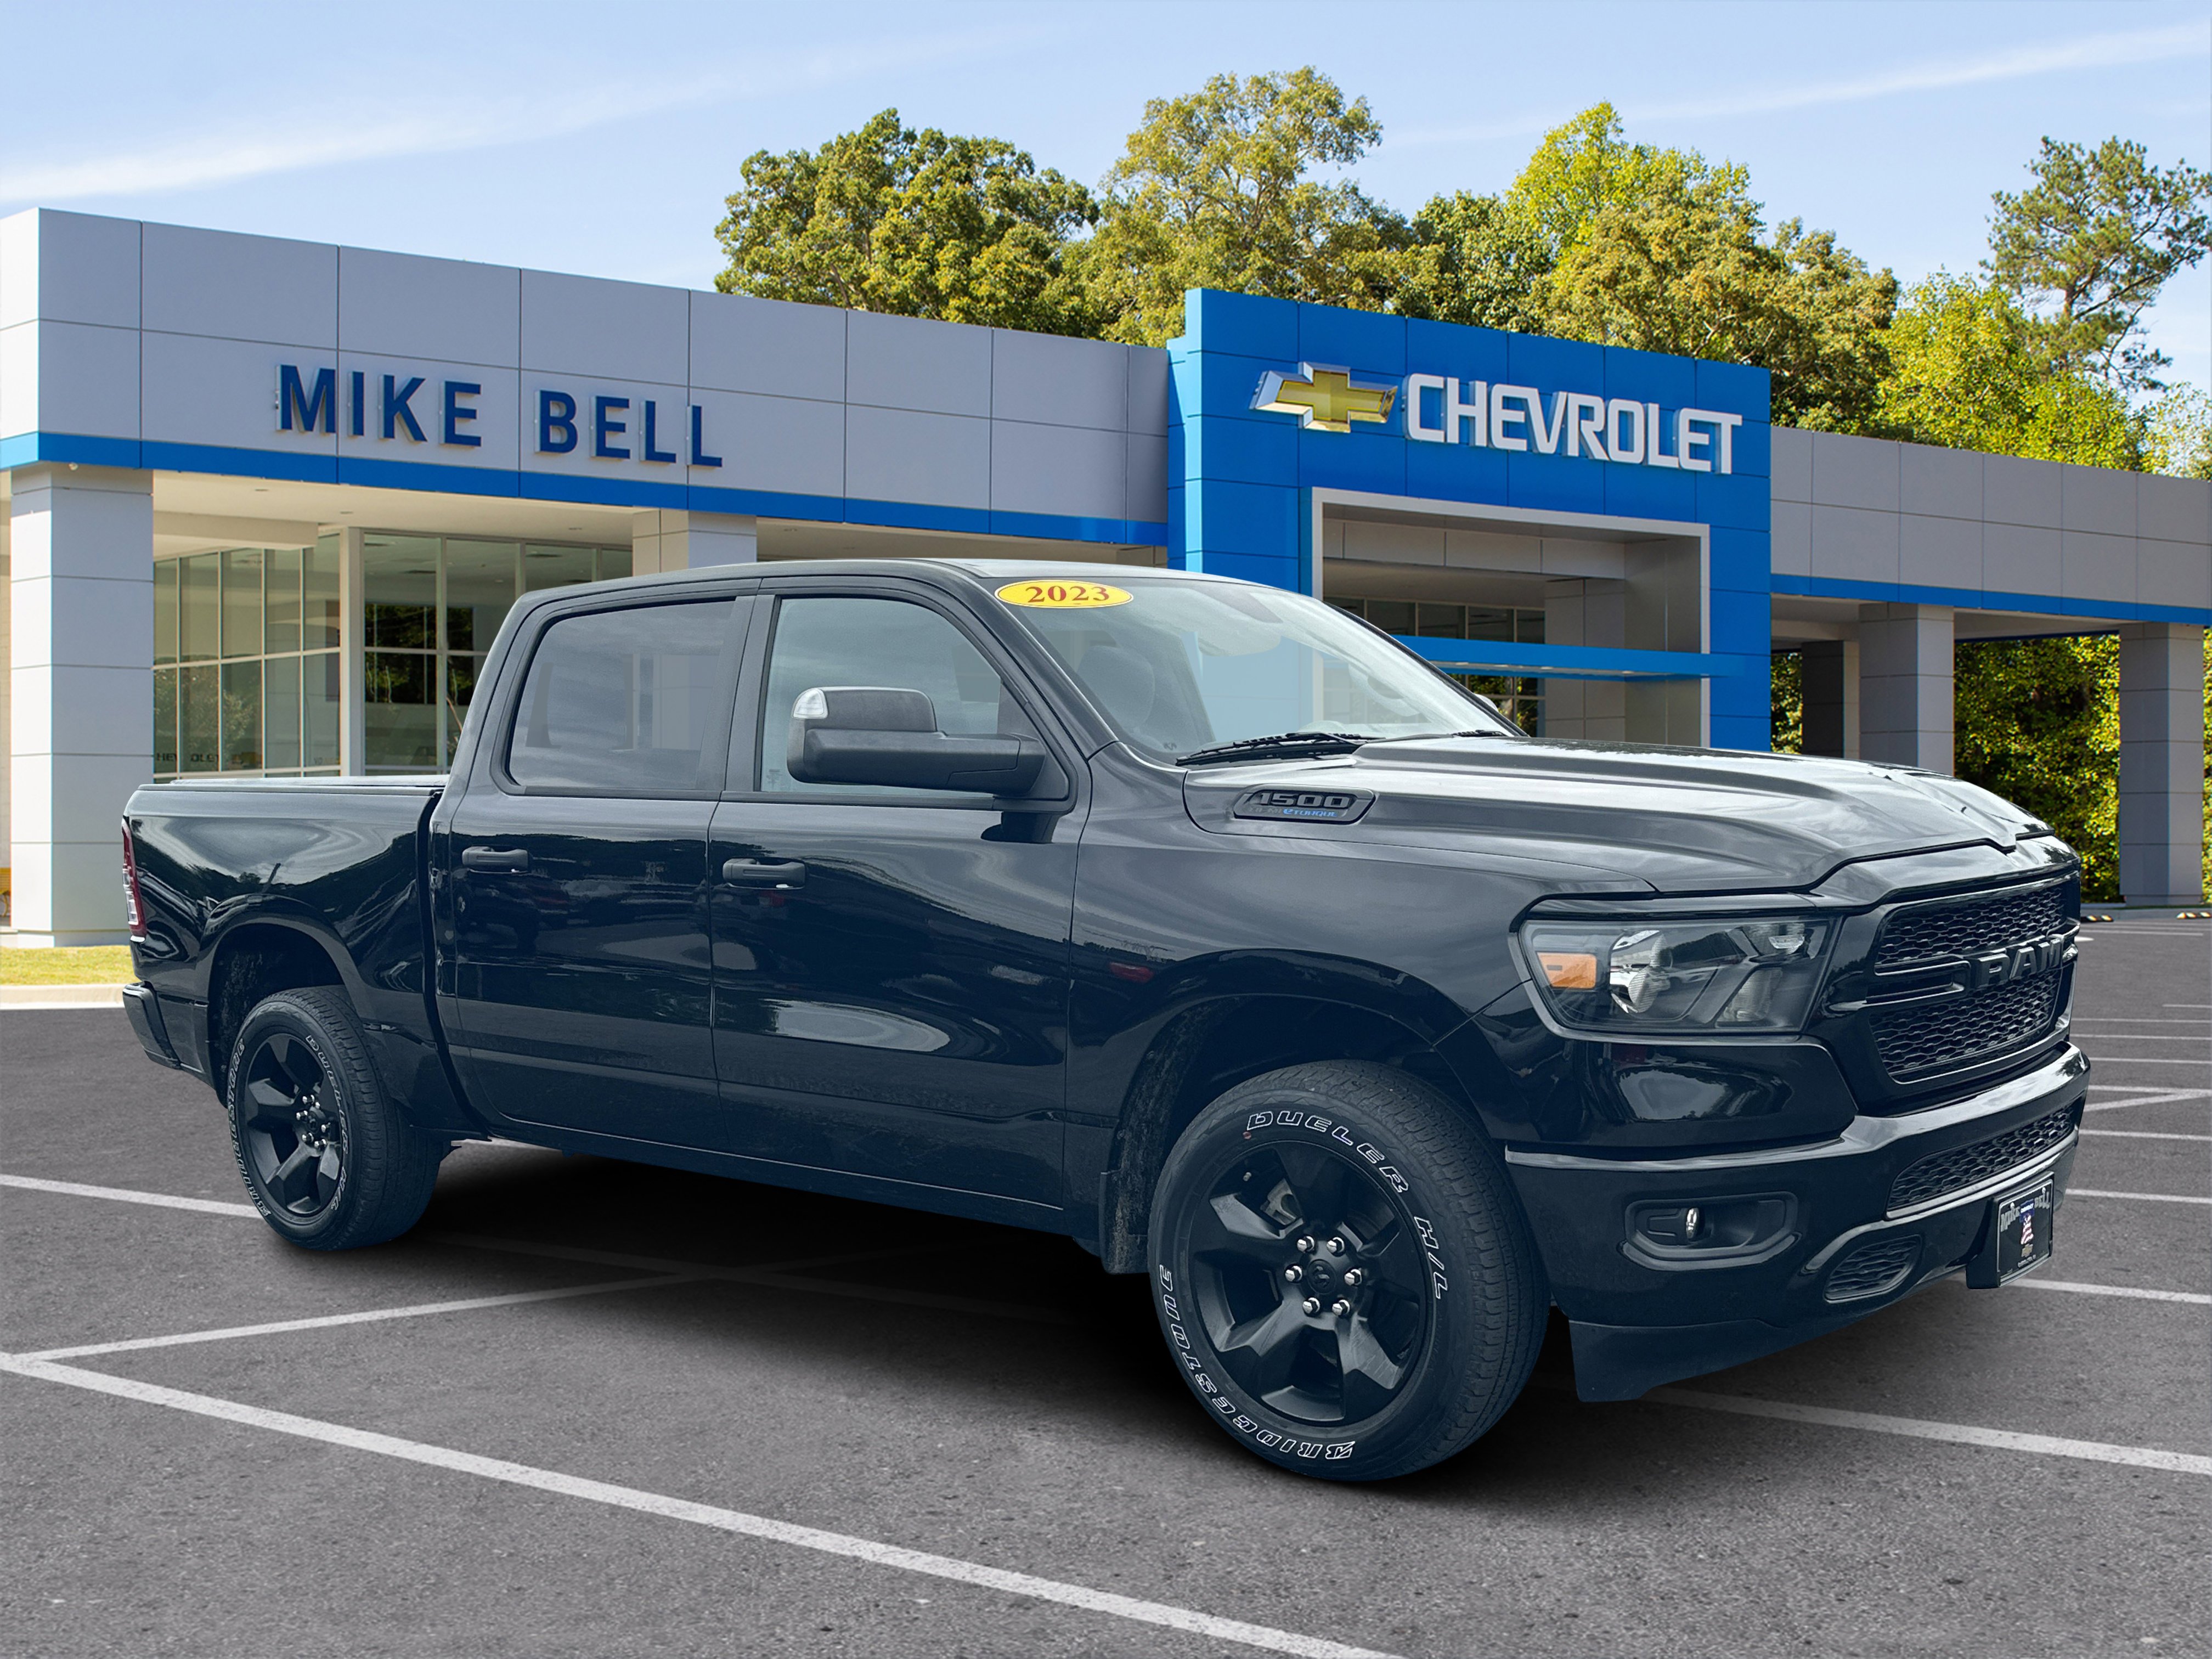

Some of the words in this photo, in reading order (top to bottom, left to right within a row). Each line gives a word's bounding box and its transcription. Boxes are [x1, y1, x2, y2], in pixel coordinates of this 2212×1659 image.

[275, 364, 482, 447] MIKE
[534, 389, 723, 468] BELL
[1403, 373, 1742, 475] CHEVROLET
[1025, 585, 1109, 602] 2023
[1257, 791, 1350, 809] 1500
[1977, 938, 2062, 987] RAM
[1246, 1110, 1409, 1193] DUELER
[1414, 1215, 1448, 1300] H/L
[1159, 1264, 1356, 1460] BRIDGESTONE
